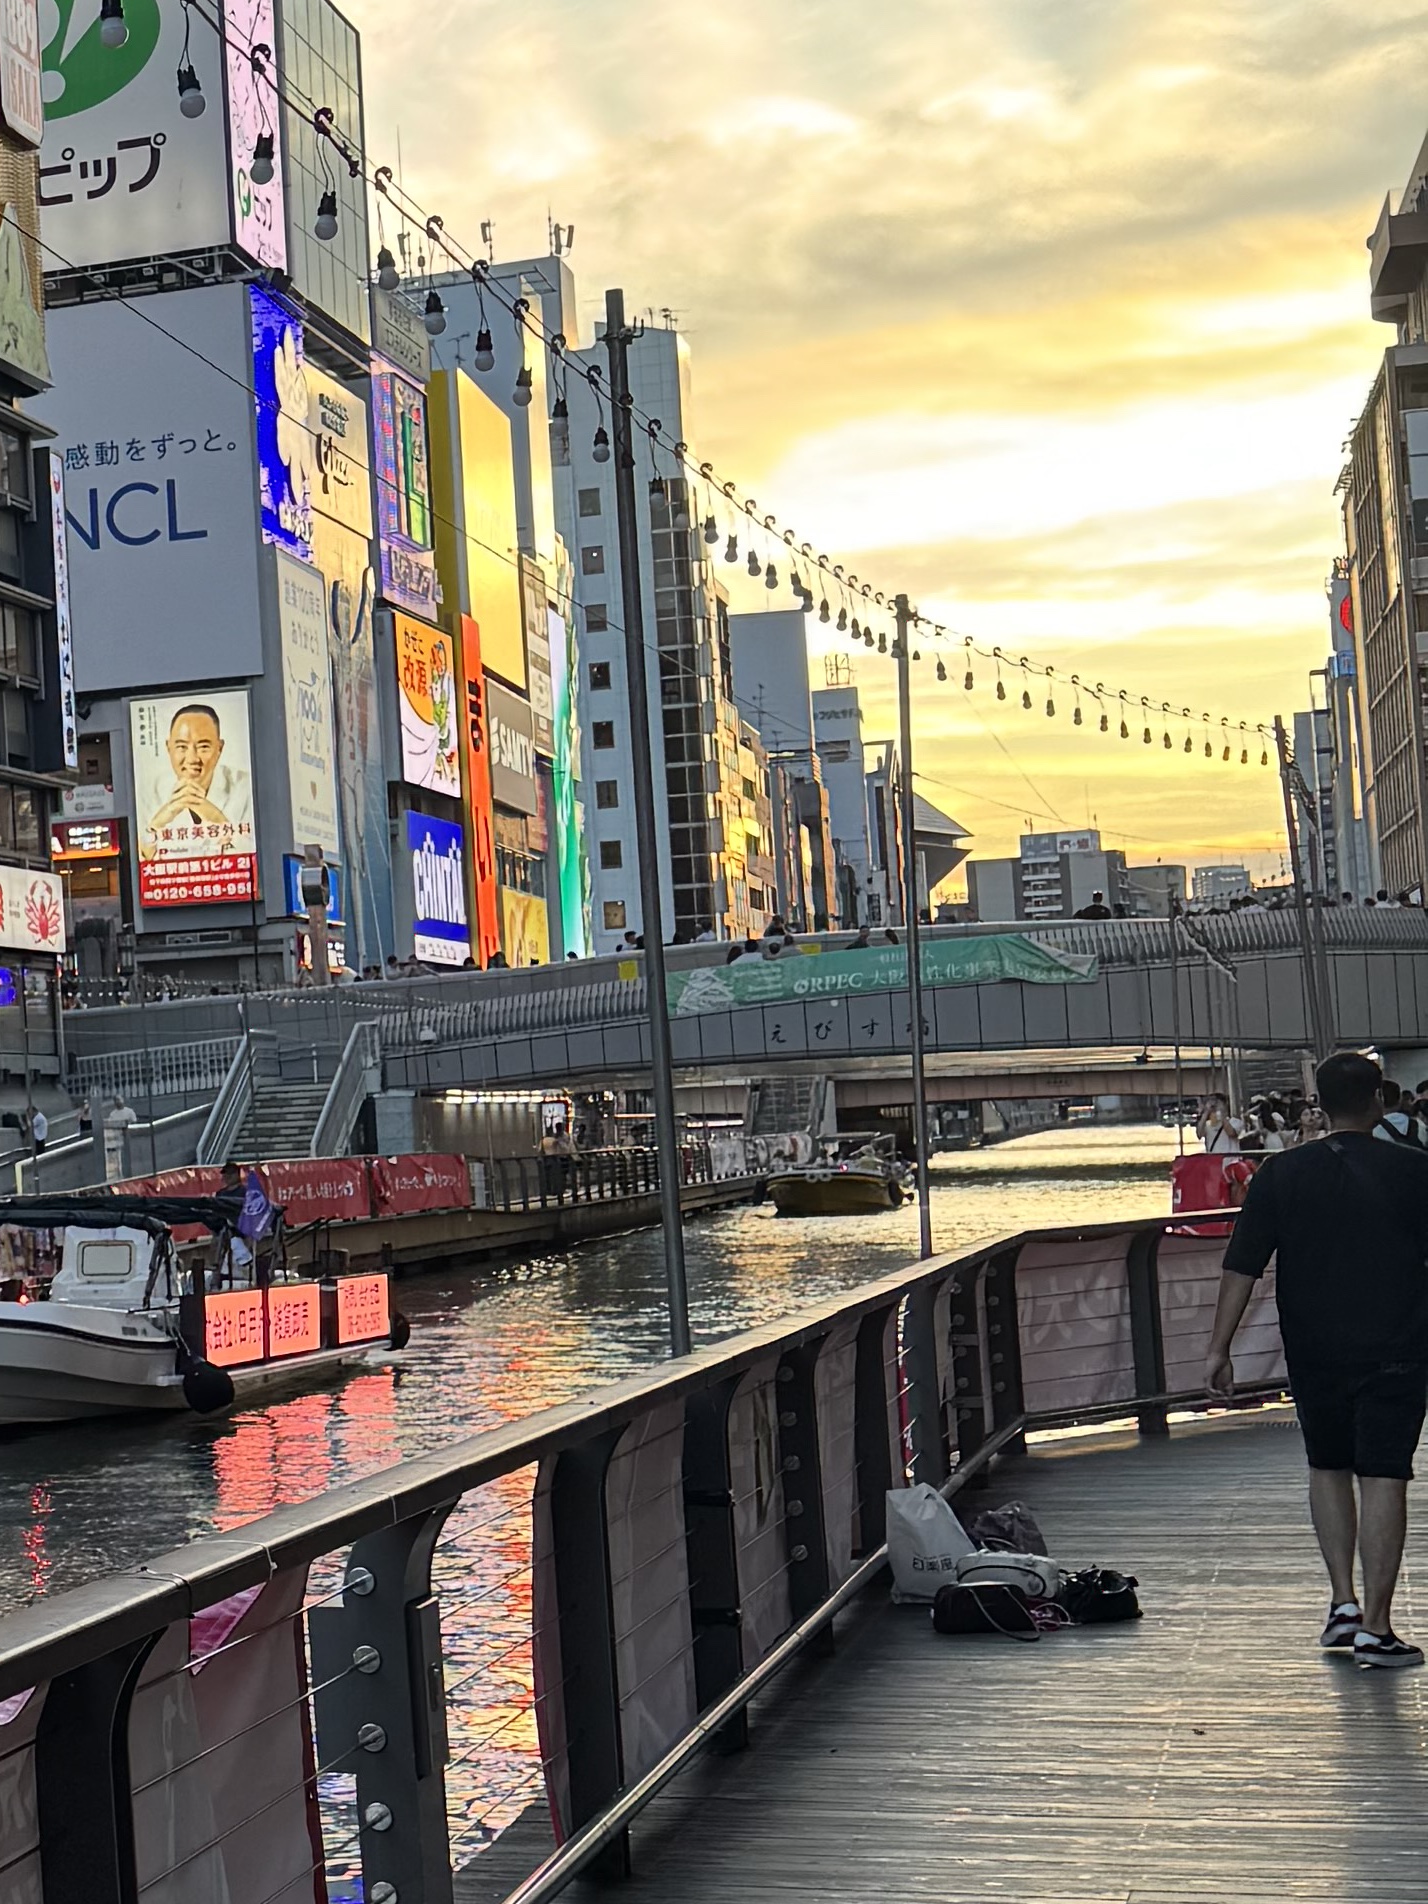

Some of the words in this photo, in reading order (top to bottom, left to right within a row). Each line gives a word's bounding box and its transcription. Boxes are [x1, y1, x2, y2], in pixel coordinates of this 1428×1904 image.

[64, 428, 238, 472] 感動をずっと。
[161, 822, 252, 843] 東京美容外科
